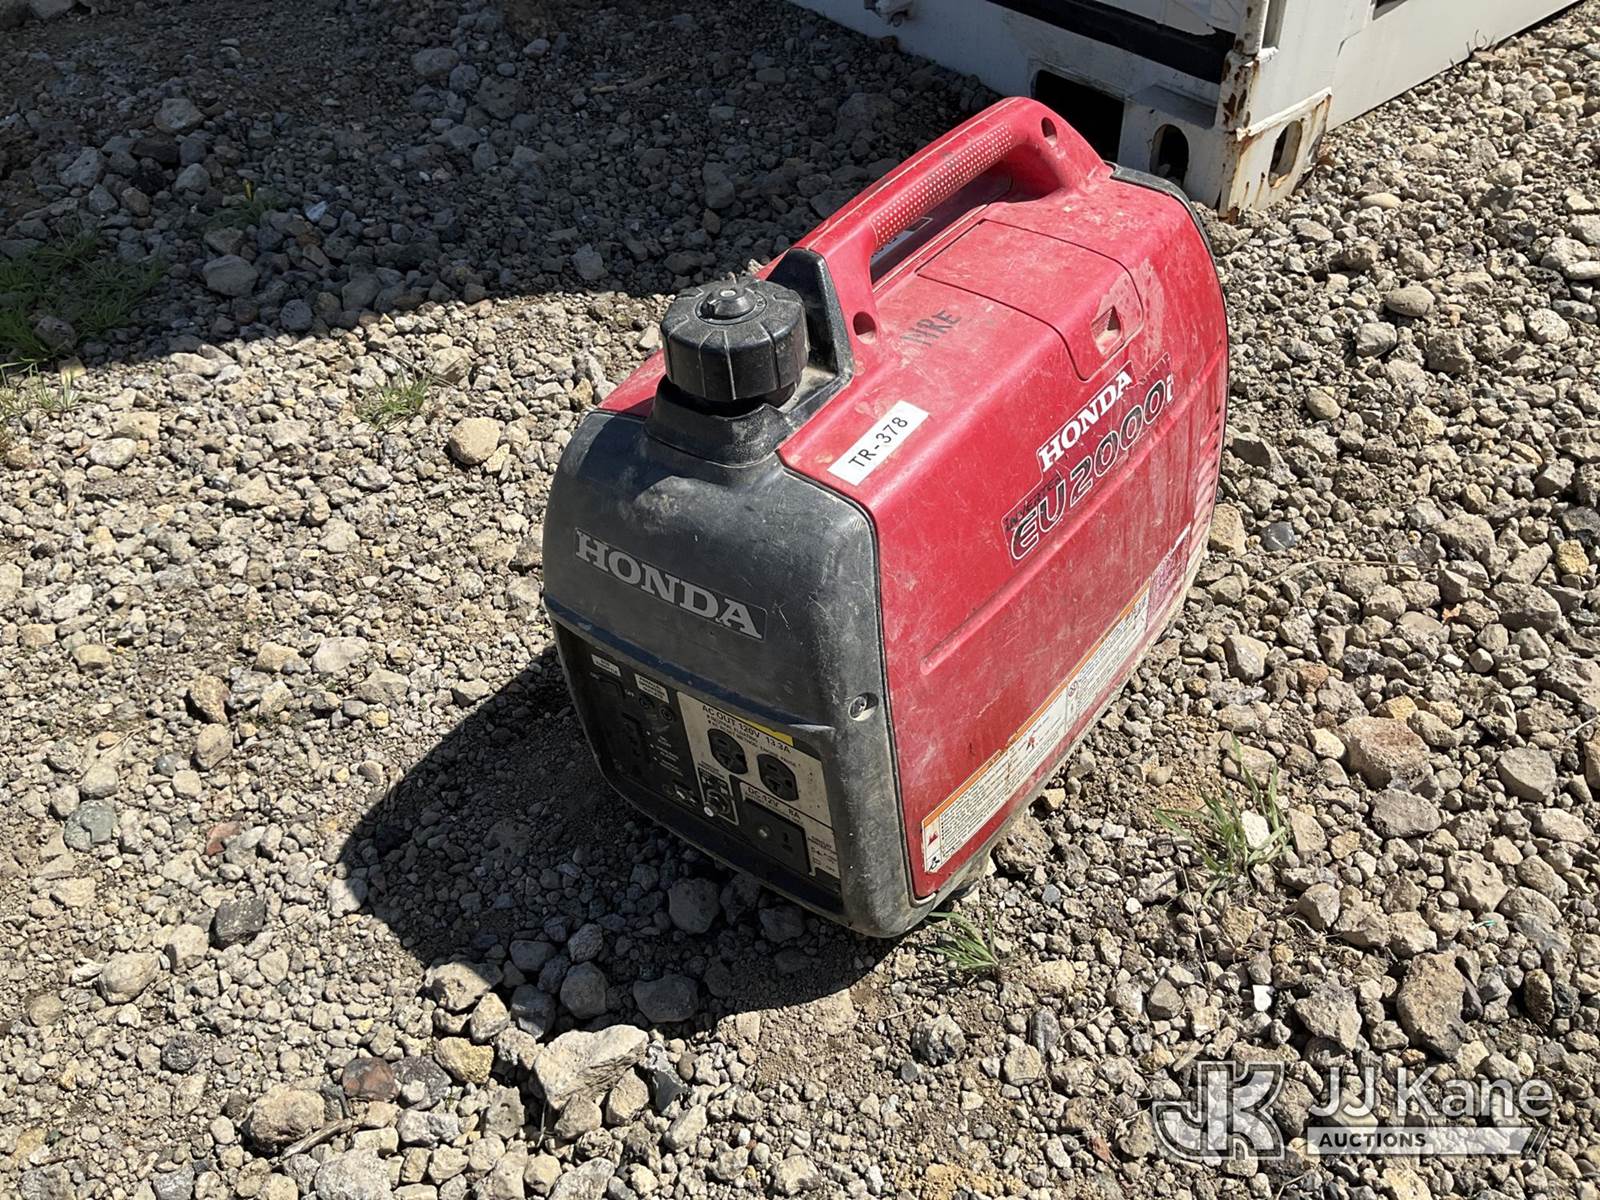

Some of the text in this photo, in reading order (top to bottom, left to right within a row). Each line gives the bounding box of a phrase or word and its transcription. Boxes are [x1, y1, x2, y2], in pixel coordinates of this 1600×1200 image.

[847, 416, 908, 468] TR-378
[1038, 370, 1133, 473] HONDA
[575, 529, 762, 641] HONDA
[702, 704, 715, 716] AC
[716, 711, 736, 726] OUT
[738, 723, 760, 738] 120V
